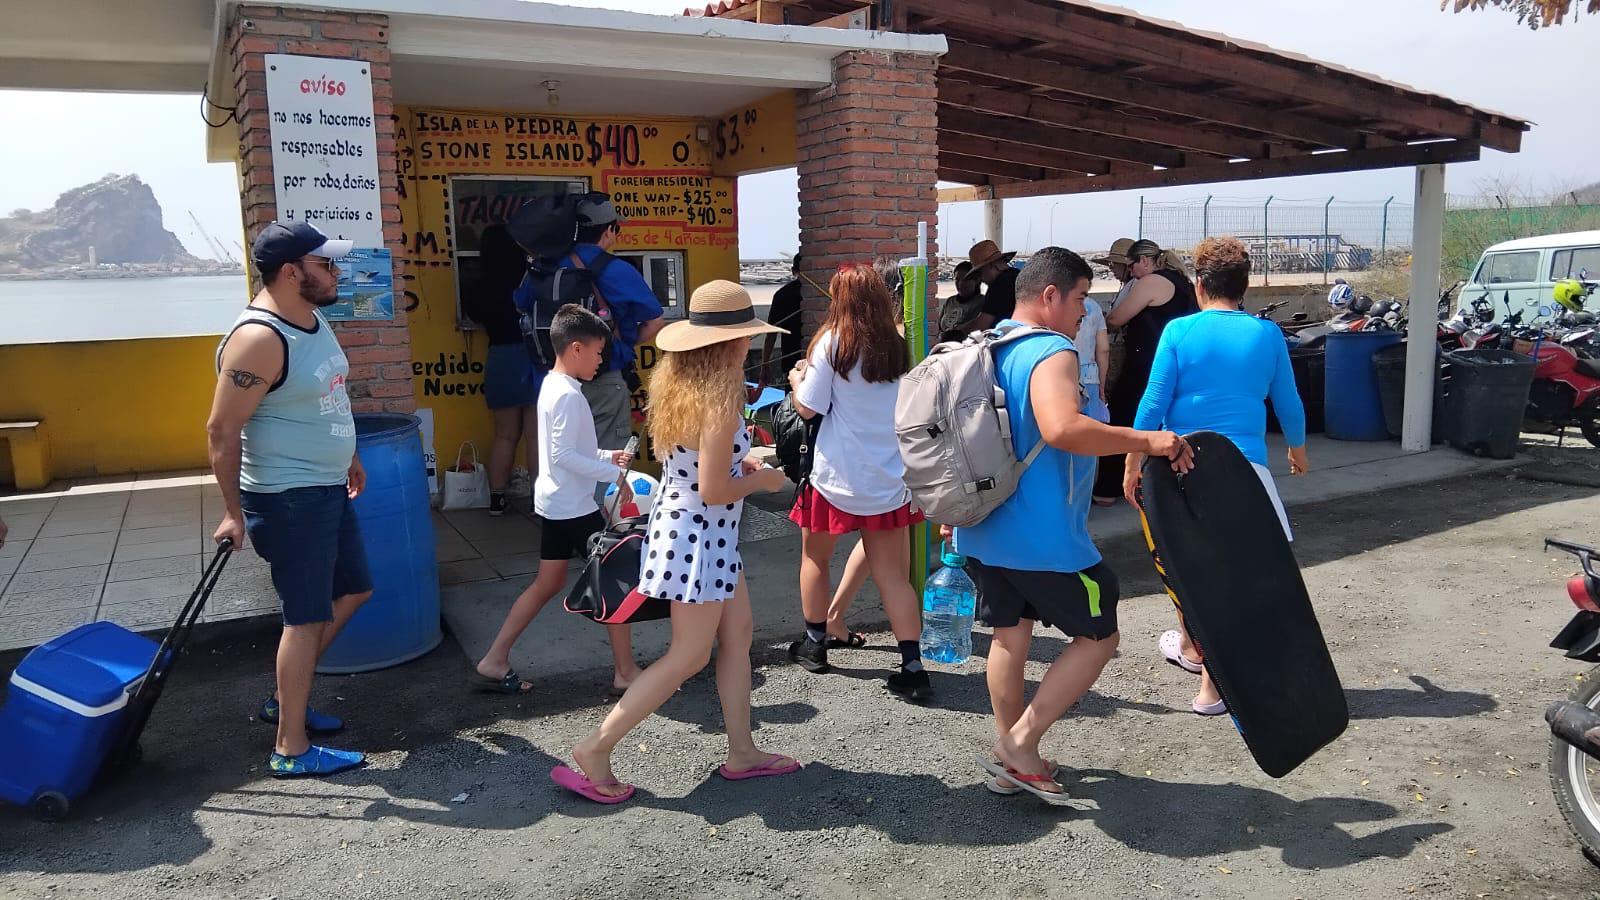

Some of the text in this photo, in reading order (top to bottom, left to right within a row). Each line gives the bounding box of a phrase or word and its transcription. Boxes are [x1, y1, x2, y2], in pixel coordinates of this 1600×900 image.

[300, 74, 346, 96] aviso
[274, 109, 371, 127] no nos hacemos
[416, 113, 578, 136] ISLA DE LA PIEDRA
[281, 139, 363, 158] responsables
[420, 142, 584, 162] STONE ISLAND
[283, 175, 306, 191] por
[613, 176, 712, 188] FOREIGN RESIDENT
[614, 192, 639, 203] ONE
[286, 206, 373, 223] y perjuicios a
[615, 205, 649, 217] ROUND
[644, 228, 659, 245] de
[664, 229, 672, 244] 4
[675, 233, 706, 246] años
[412, 352, 484, 376] erdido
